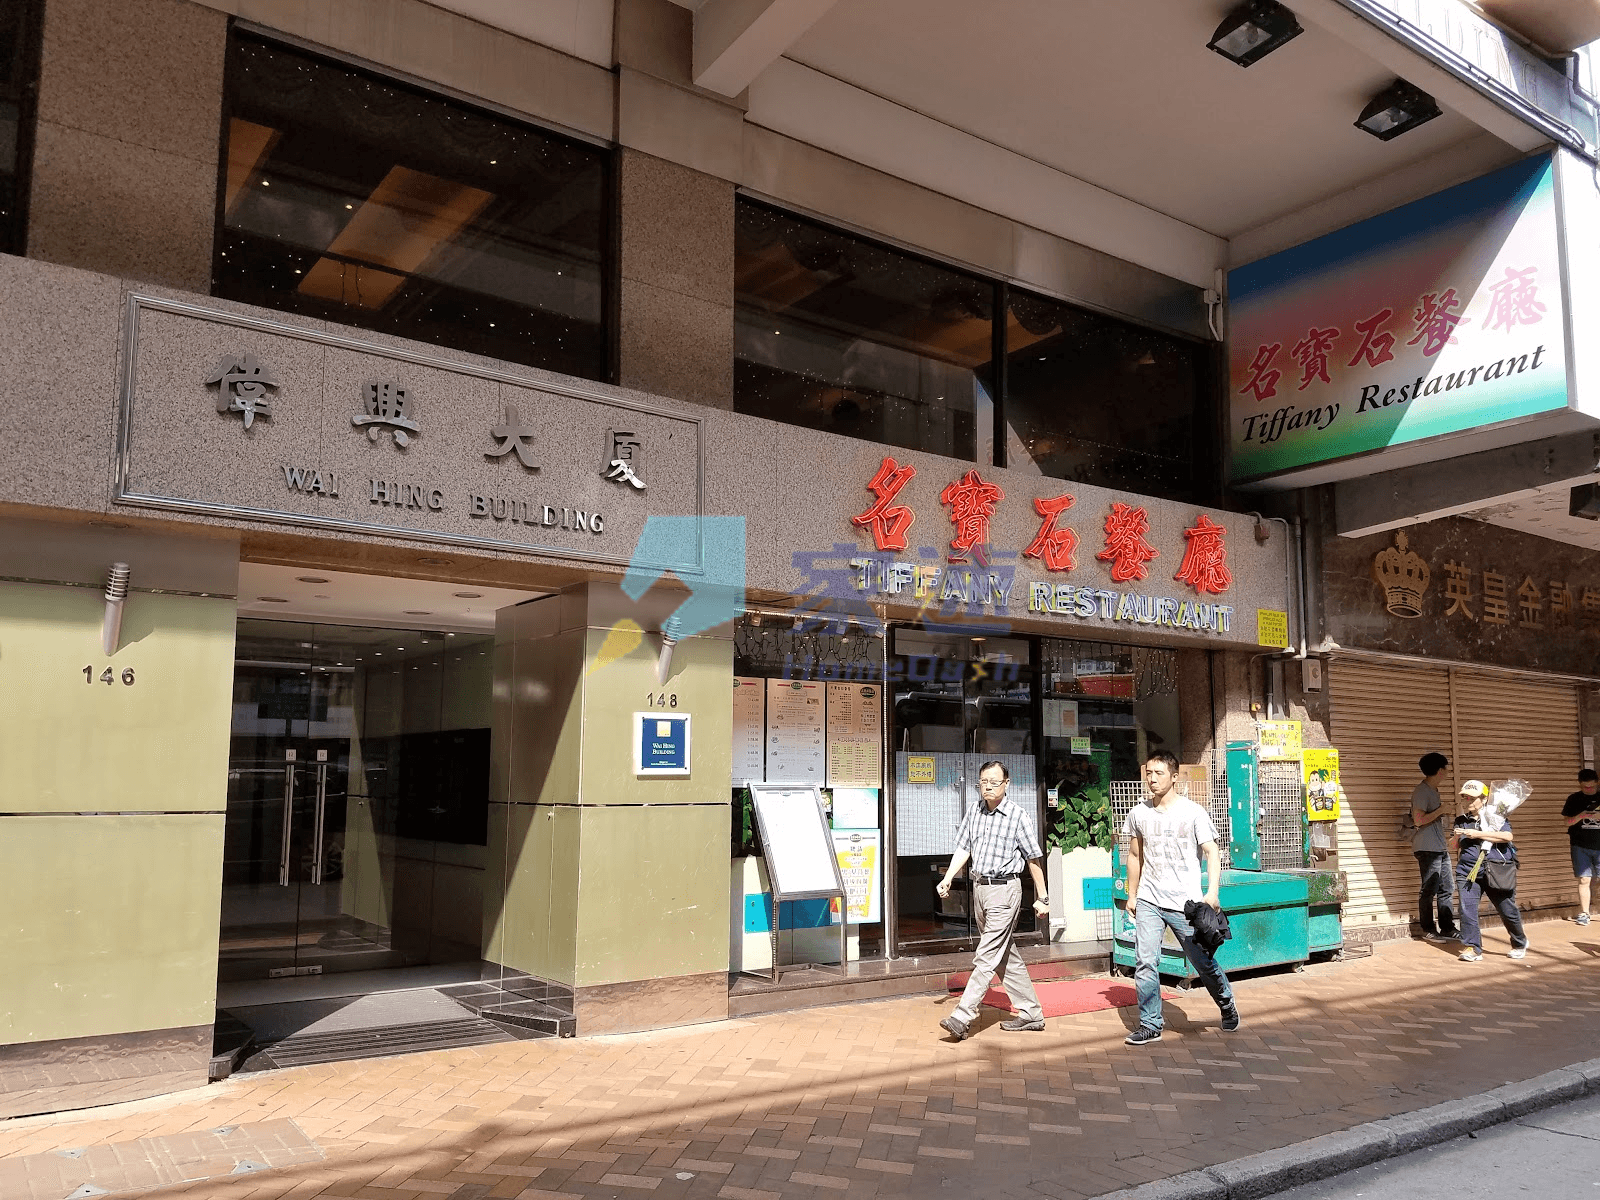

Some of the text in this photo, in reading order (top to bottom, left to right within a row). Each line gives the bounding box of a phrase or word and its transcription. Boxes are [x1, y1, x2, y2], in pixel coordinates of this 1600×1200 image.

[1239, 266, 1547, 402] 名寶石餐廳
[1242, 344, 1546, 444] Tiffany Restaurant
[281, 465, 604, 533] WAI HING BUILDING
[850, 456, 1233, 594] 名寶石餐廳
[850, 557, 1015, 606] TIFFANY
[1028, 581, 1234, 633] RESTAURANT
[82, 665, 135, 686] 146
[646, 692, 677, 708] 148
